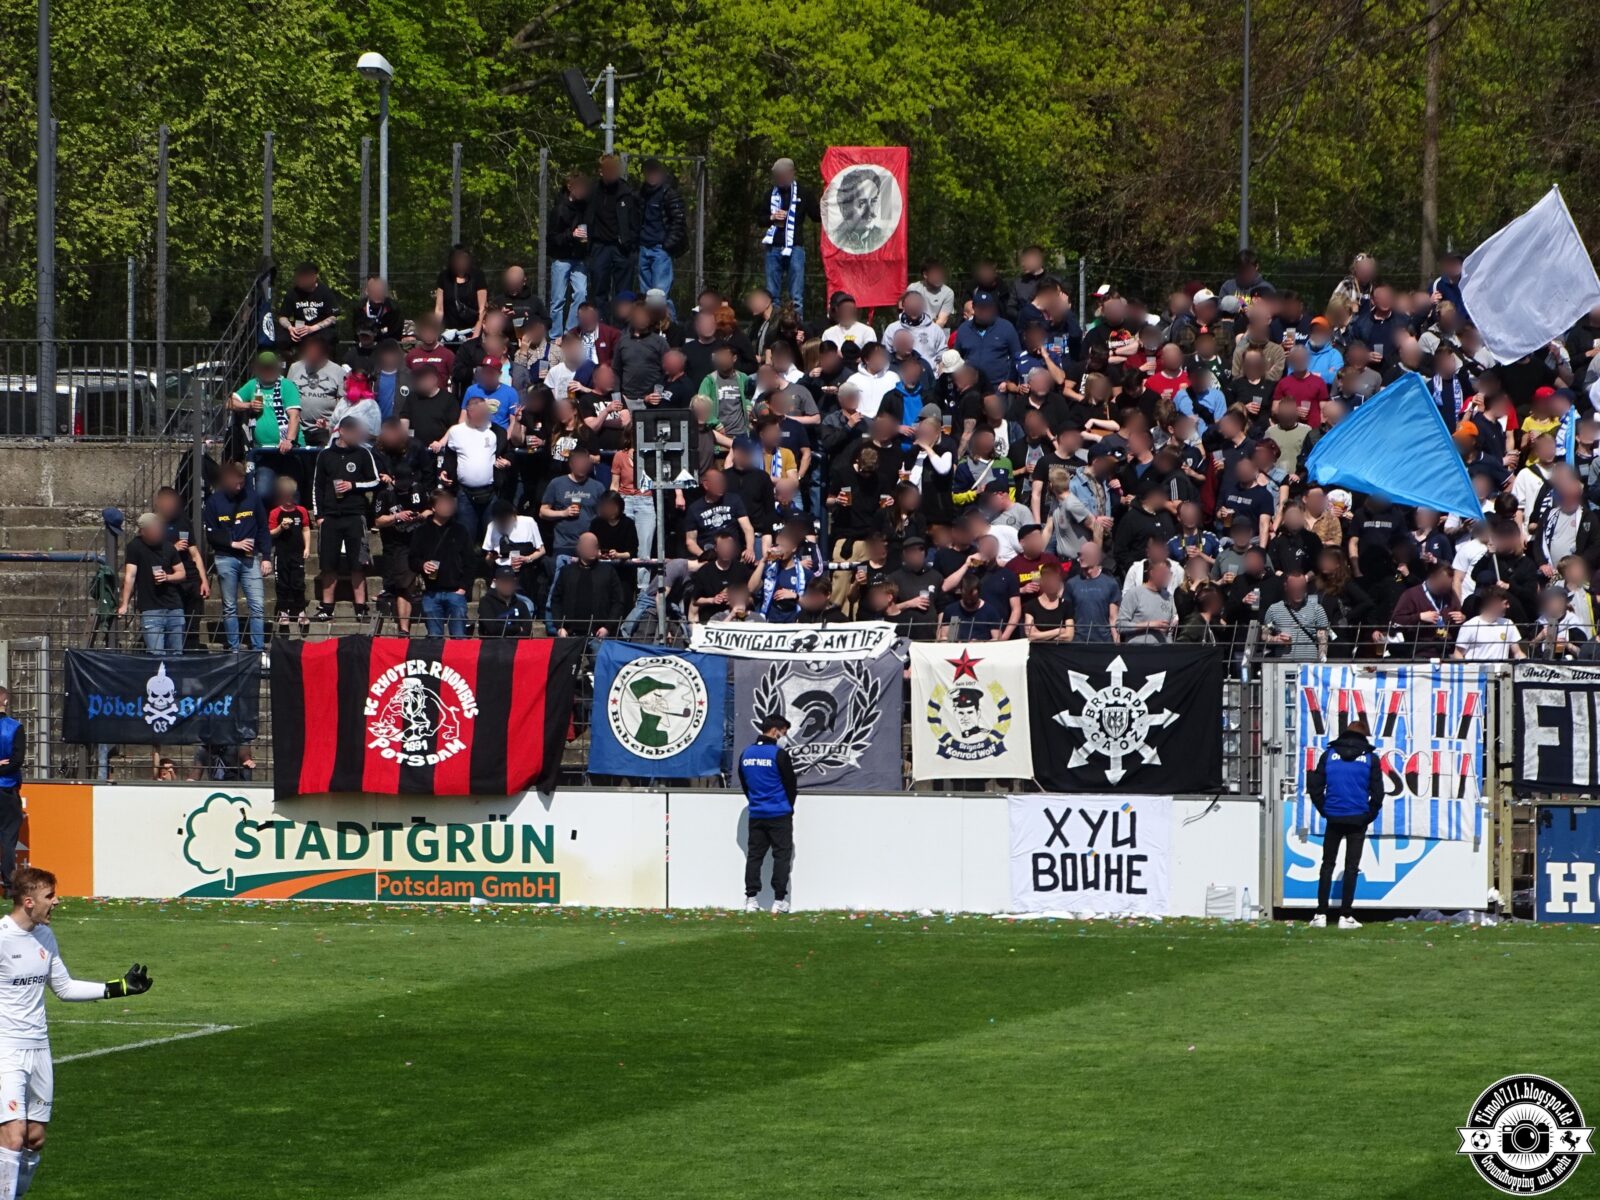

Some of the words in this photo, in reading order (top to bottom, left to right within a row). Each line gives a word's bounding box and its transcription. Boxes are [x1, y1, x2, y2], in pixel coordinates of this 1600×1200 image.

[370, 659, 430, 697] RHOTER
[613, 670, 631, 692] La
[634, 658, 702, 693] Coppola
[1523, 667, 1561, 682] Antifa
[429, 660, 479, 719] RHOMBUS
[1085, 687, 1146, 718] BRIGADA
[88, 694, 144, 719] Pöbel
[178, 695, 233, 718] Block
[364, 697, 379, 716] FC
[1303, 687, 1413, 738] VIVA
[1432, 690, 1485, 742] LA
[153, 720, 168, 733] 03
[611, 709, 693, 756] Babelsberg
[692, 709, 704, 728] 03
[1522, 688, 1600, 785] FI
[368, 737, 467, 766] POTSDAM
[403, 740, 428, 751] 1991
[945, 747, 977, 759] Konrad
[978, 744, 997, 758] Wolf
[959, 742, 985, 752] Brigade
[234, 814, 554, 864] STADTGRÜN
[377, 874, 475, 897] Potsdam
[481, 876, 555, 898] GmbH
